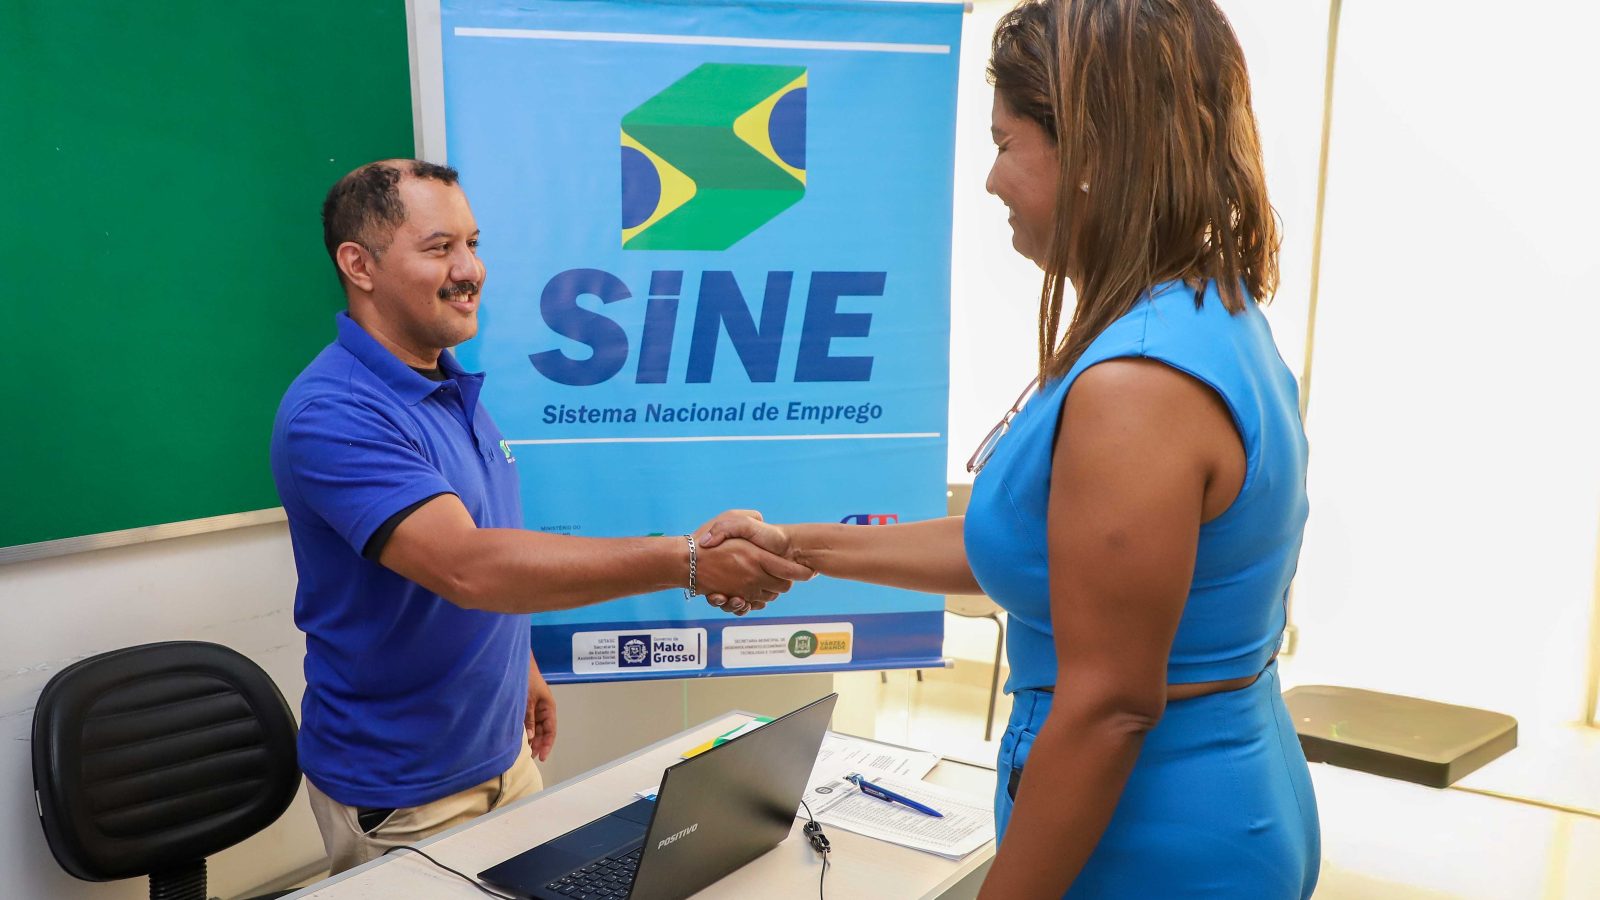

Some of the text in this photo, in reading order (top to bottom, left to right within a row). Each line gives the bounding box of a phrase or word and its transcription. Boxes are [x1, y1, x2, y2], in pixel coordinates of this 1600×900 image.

[542, 402, 883, 424] Sistema Nacional de Emprego
[653, 642, 684, 652] Mato
[653, 652, 695, 663] Grosso
[657, 823, 698, 850] POSITIVO
